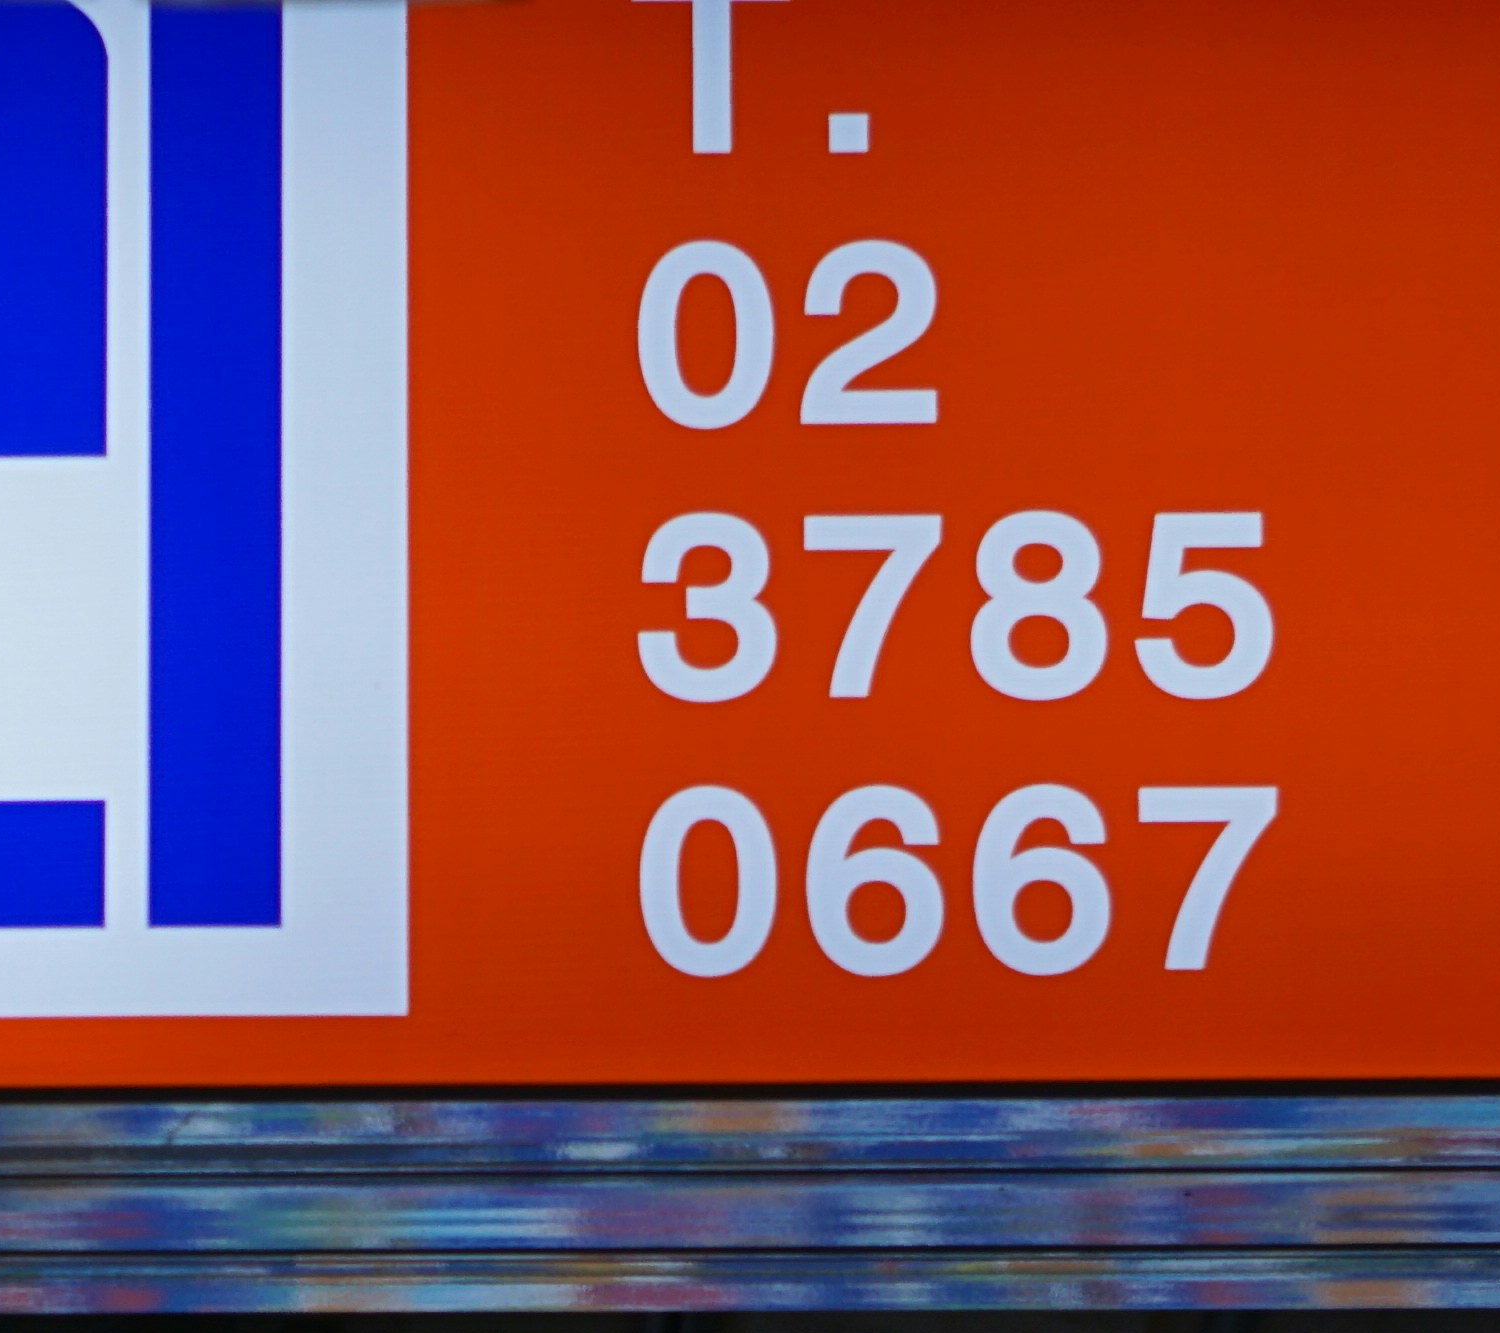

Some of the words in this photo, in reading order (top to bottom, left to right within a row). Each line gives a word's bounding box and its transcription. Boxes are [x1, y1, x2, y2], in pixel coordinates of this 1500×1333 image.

[637, 239, 938, 430] 02
[637, 510, 1274, 703] 3785
[639, 783, 1279, 977] 0667
